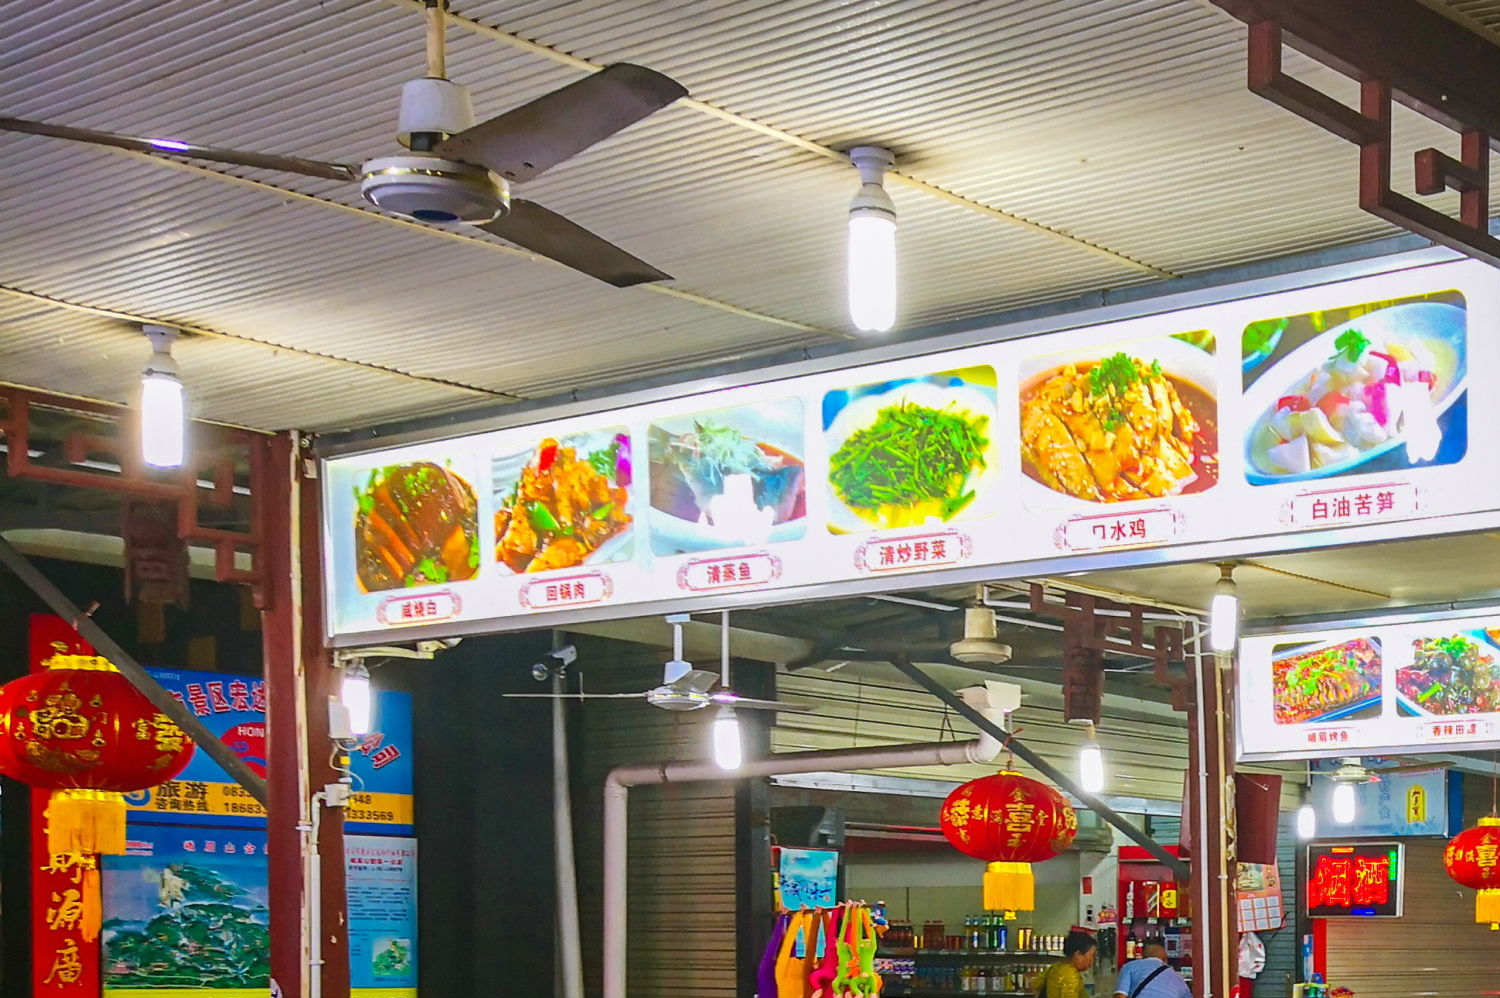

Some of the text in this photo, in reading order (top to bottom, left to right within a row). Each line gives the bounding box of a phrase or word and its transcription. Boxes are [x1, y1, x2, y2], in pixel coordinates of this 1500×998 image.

[1311, 491, 1396, 520] 白油苦笋
[879, 540, 947, 563] 清炒野菜
[707, 564, 752, 584] 清蒸鱼
[546, 582, 586, 601] 回锅肉
[156, 781, 208, 800] 旅游
[224, 803, 268, 815] 18683
[1005, 803, 1035, 832] 喜
